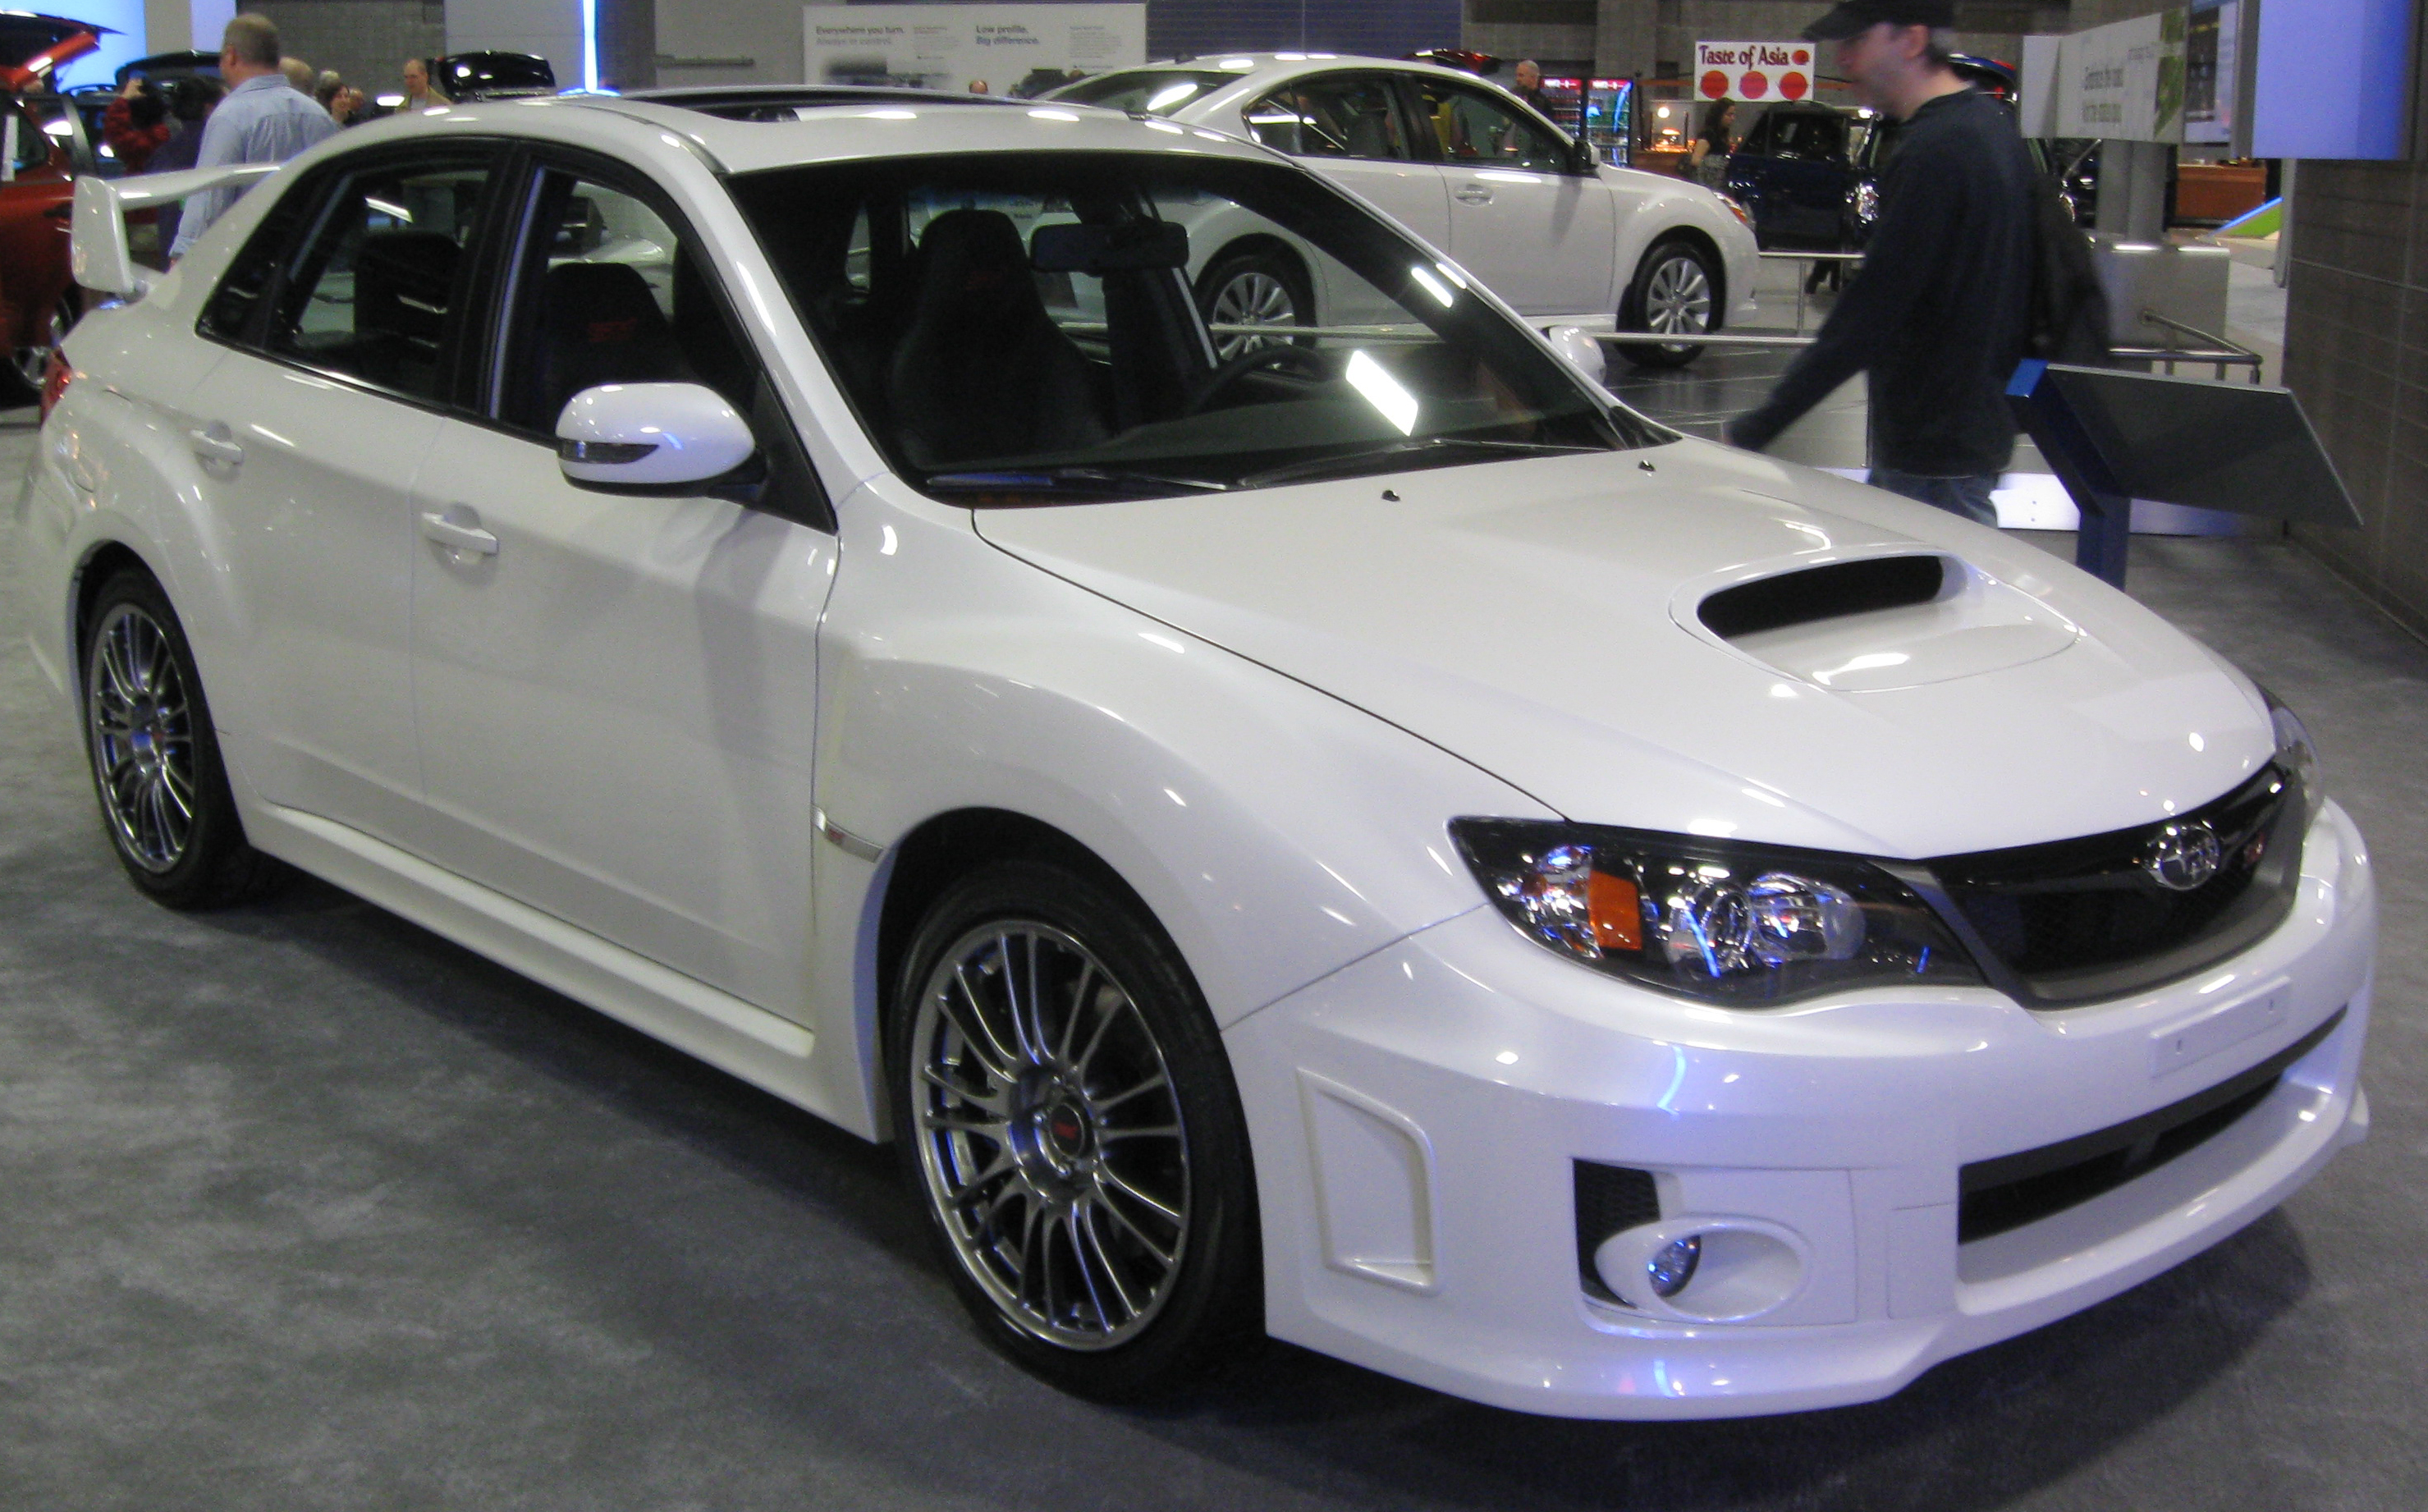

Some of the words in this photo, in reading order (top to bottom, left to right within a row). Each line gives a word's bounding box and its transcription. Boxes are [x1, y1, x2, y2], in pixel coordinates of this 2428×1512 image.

[976, 25, 995, 34] Low
[976, 36, 992, 47] Big
[1698, 44, 1735, 65] Taste
[1739, 44, 1757, 71] of
[1757, 45, 1789, 66] Asia
